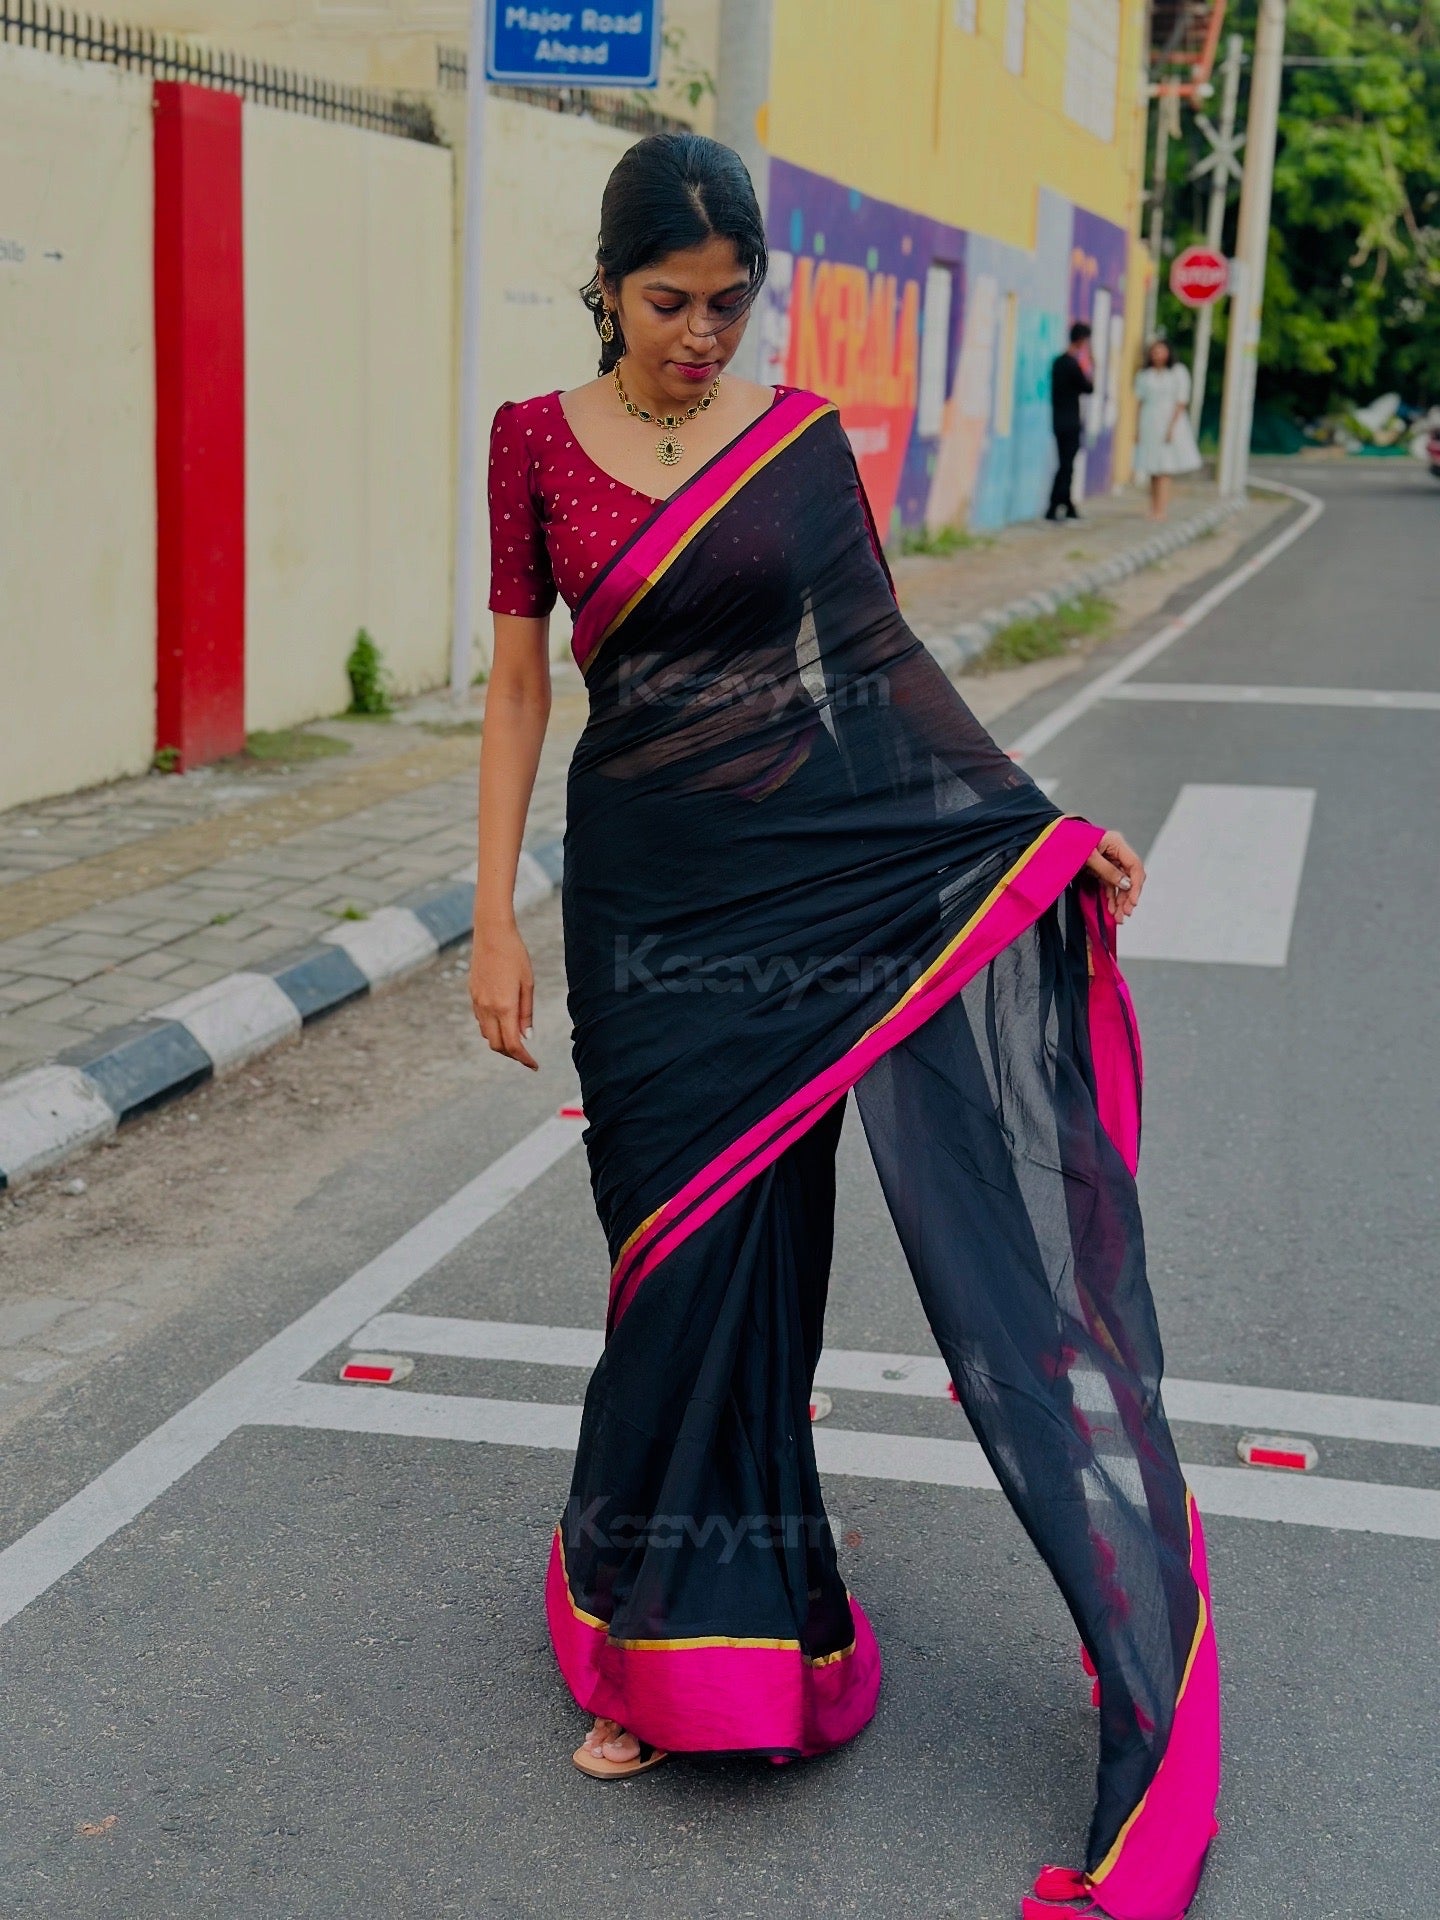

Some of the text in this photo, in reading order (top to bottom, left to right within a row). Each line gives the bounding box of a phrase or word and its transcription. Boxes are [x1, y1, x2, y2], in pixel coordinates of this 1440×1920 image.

[505, 6, 643, 35] Major Road
[535, 38, 609, 65] Ahead
[1175, 264, 1225, 288] STOP
